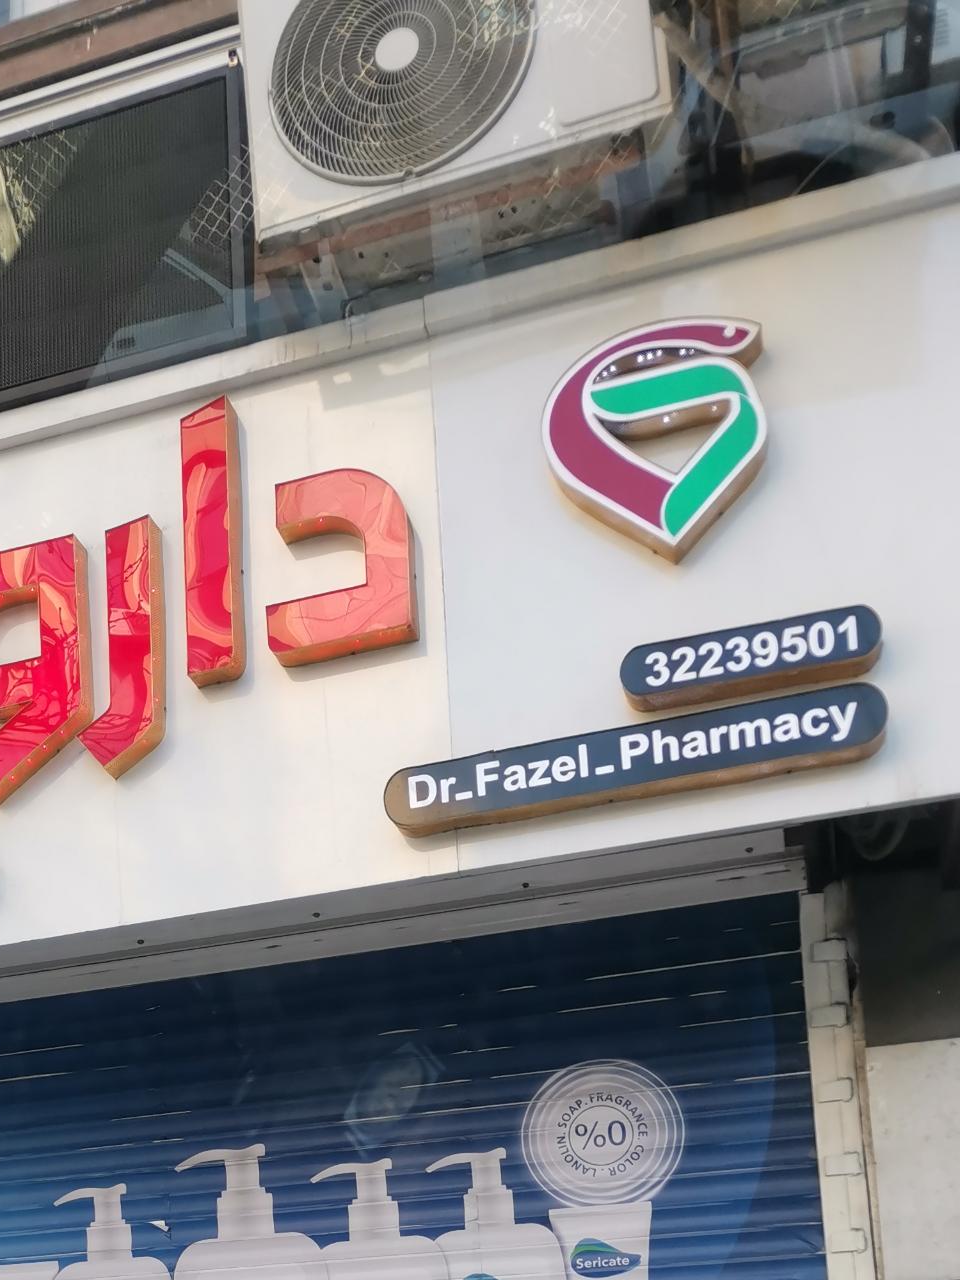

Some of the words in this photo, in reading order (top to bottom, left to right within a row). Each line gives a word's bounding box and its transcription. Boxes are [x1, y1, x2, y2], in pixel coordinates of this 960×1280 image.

[643, 614, 860, 688] 32239501
[406, 700, 858, 811] Dr_Fazel_Pharmacy
[576, 1256, 630, 1269] Sericate
